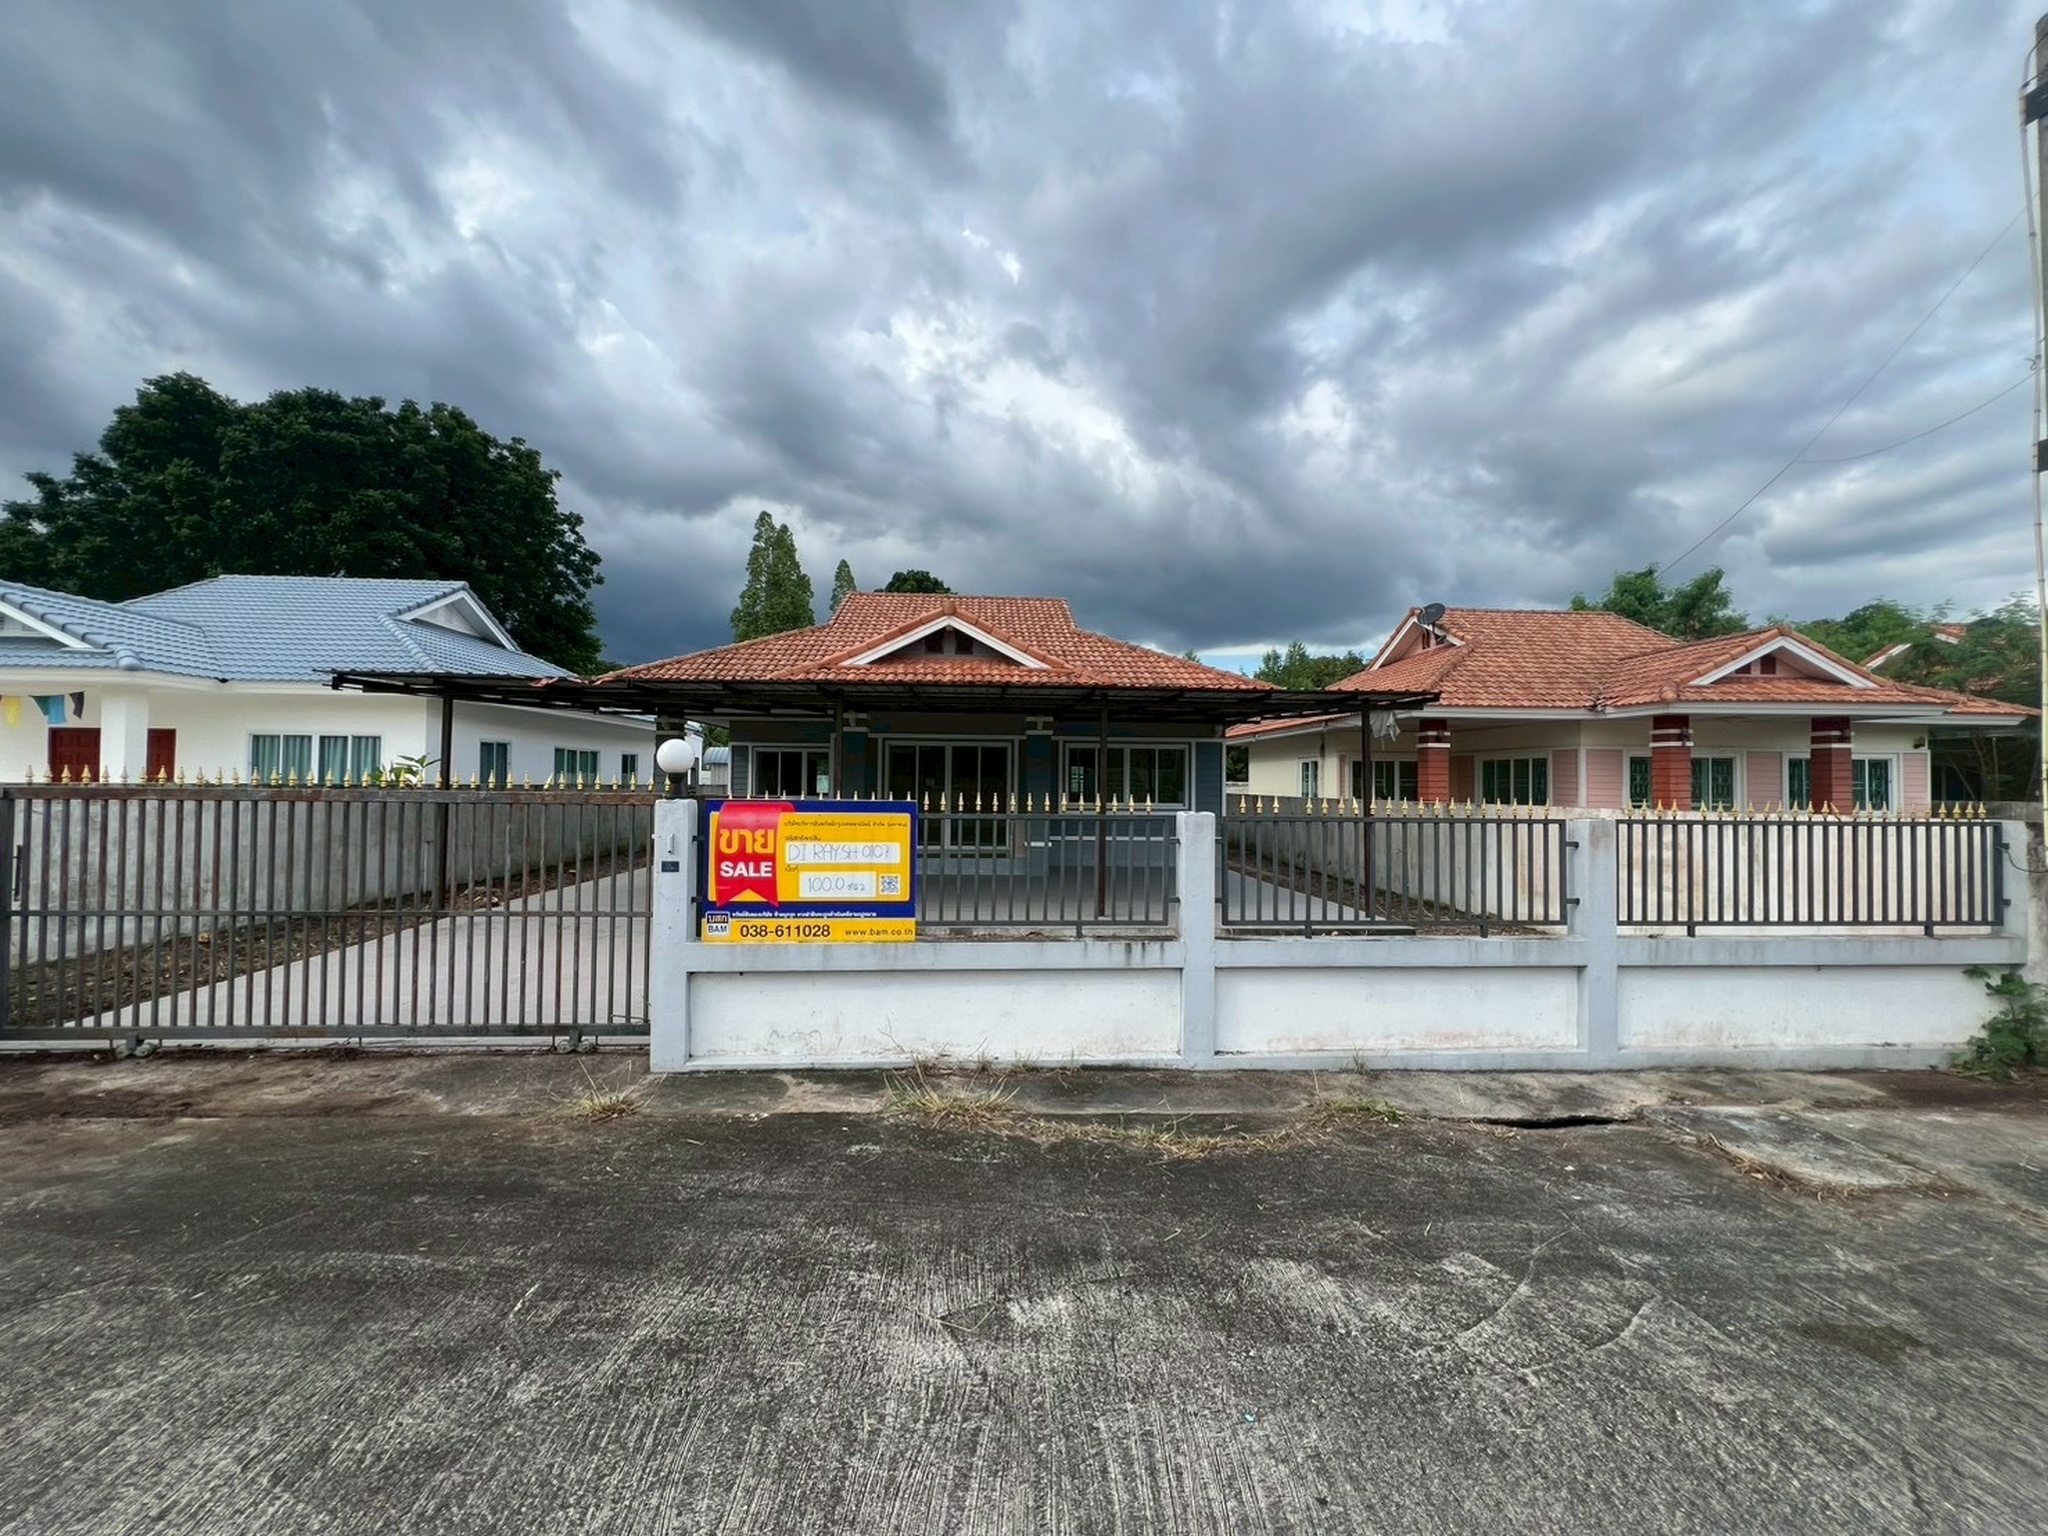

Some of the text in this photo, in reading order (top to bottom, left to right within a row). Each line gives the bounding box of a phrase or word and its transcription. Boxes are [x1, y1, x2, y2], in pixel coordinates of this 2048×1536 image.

[719, 828, 775, 854] ขาย
[720, 861, 773, 877] SALE
[808, 876, 845, 892] 100.0
[708, 925, 727, 934] BAM
[740, 924, 831, 938] 038-611028
[845, 928, 914, 936] www.bam.co.th
